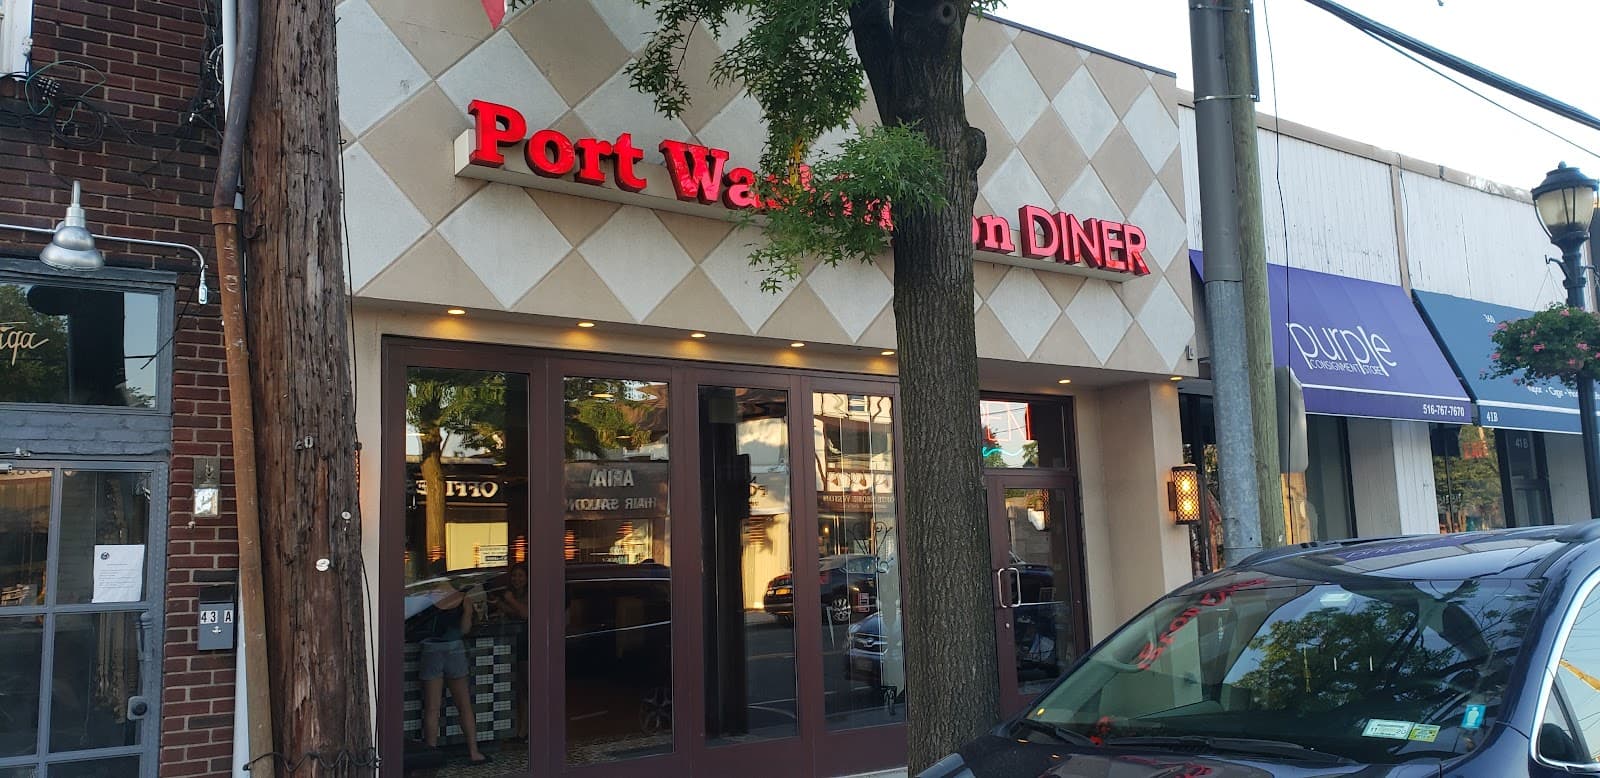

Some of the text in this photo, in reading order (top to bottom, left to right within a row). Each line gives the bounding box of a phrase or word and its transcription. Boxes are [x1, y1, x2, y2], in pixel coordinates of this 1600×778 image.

[467, 98, 647, 193] Port
[1018, 204, 1151, 277] DINER
[1285, 322, 1397, 377] purple
[1309, 359, 1385, 376] CONSIGNMENT STORE
[1422, 403, 1465, 417] 516-767-7670
[1486, 411, 1499, 422] 41B
[201, 611, 232, 623] 43 A
